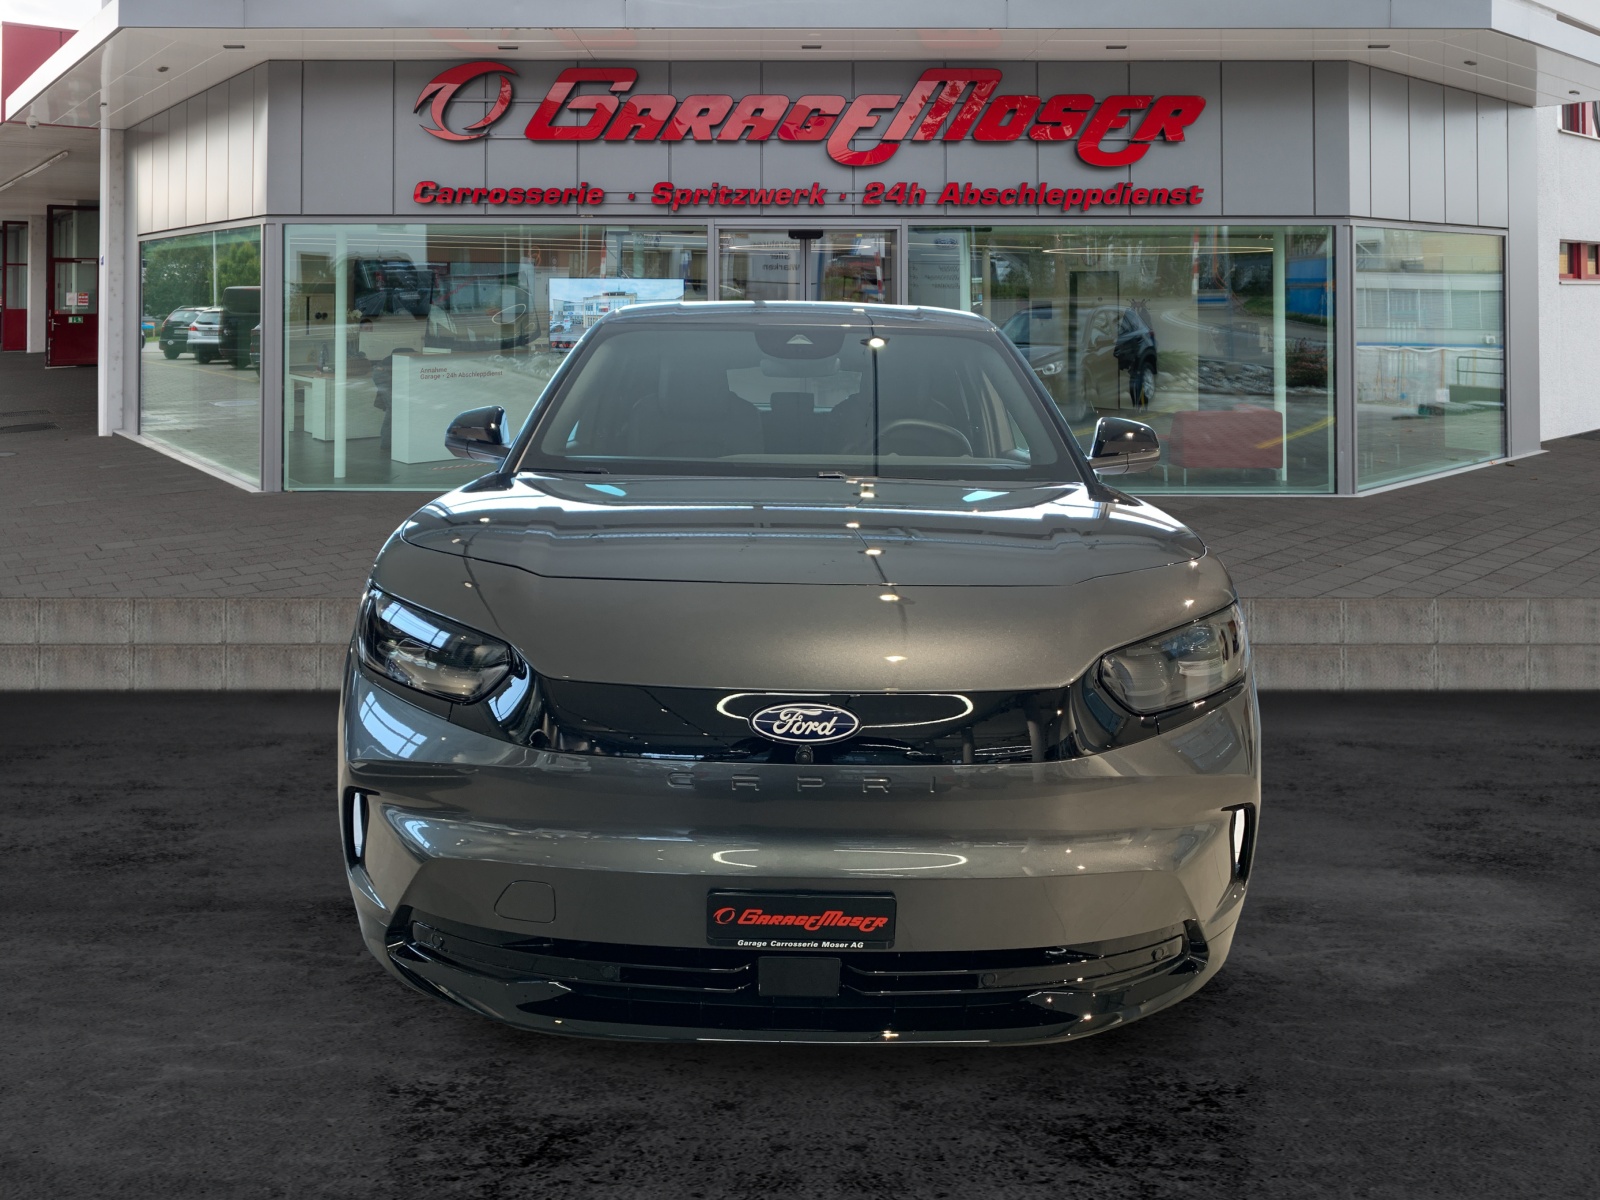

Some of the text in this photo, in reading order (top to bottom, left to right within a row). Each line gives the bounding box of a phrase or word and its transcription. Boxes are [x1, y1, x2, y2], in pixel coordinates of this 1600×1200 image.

[413, 181, 1204, 212] Carrosserie Spritzwerk 24h Abschleppdienst
[458, 370, 503, 378] Abschleppdienst
[773, 708, 838, 736] Ford
[667, 772, 937, 793] CAPRI
[737, 939, 767, 948] Garage
[770, 940, 819, 948] Carrosserie
